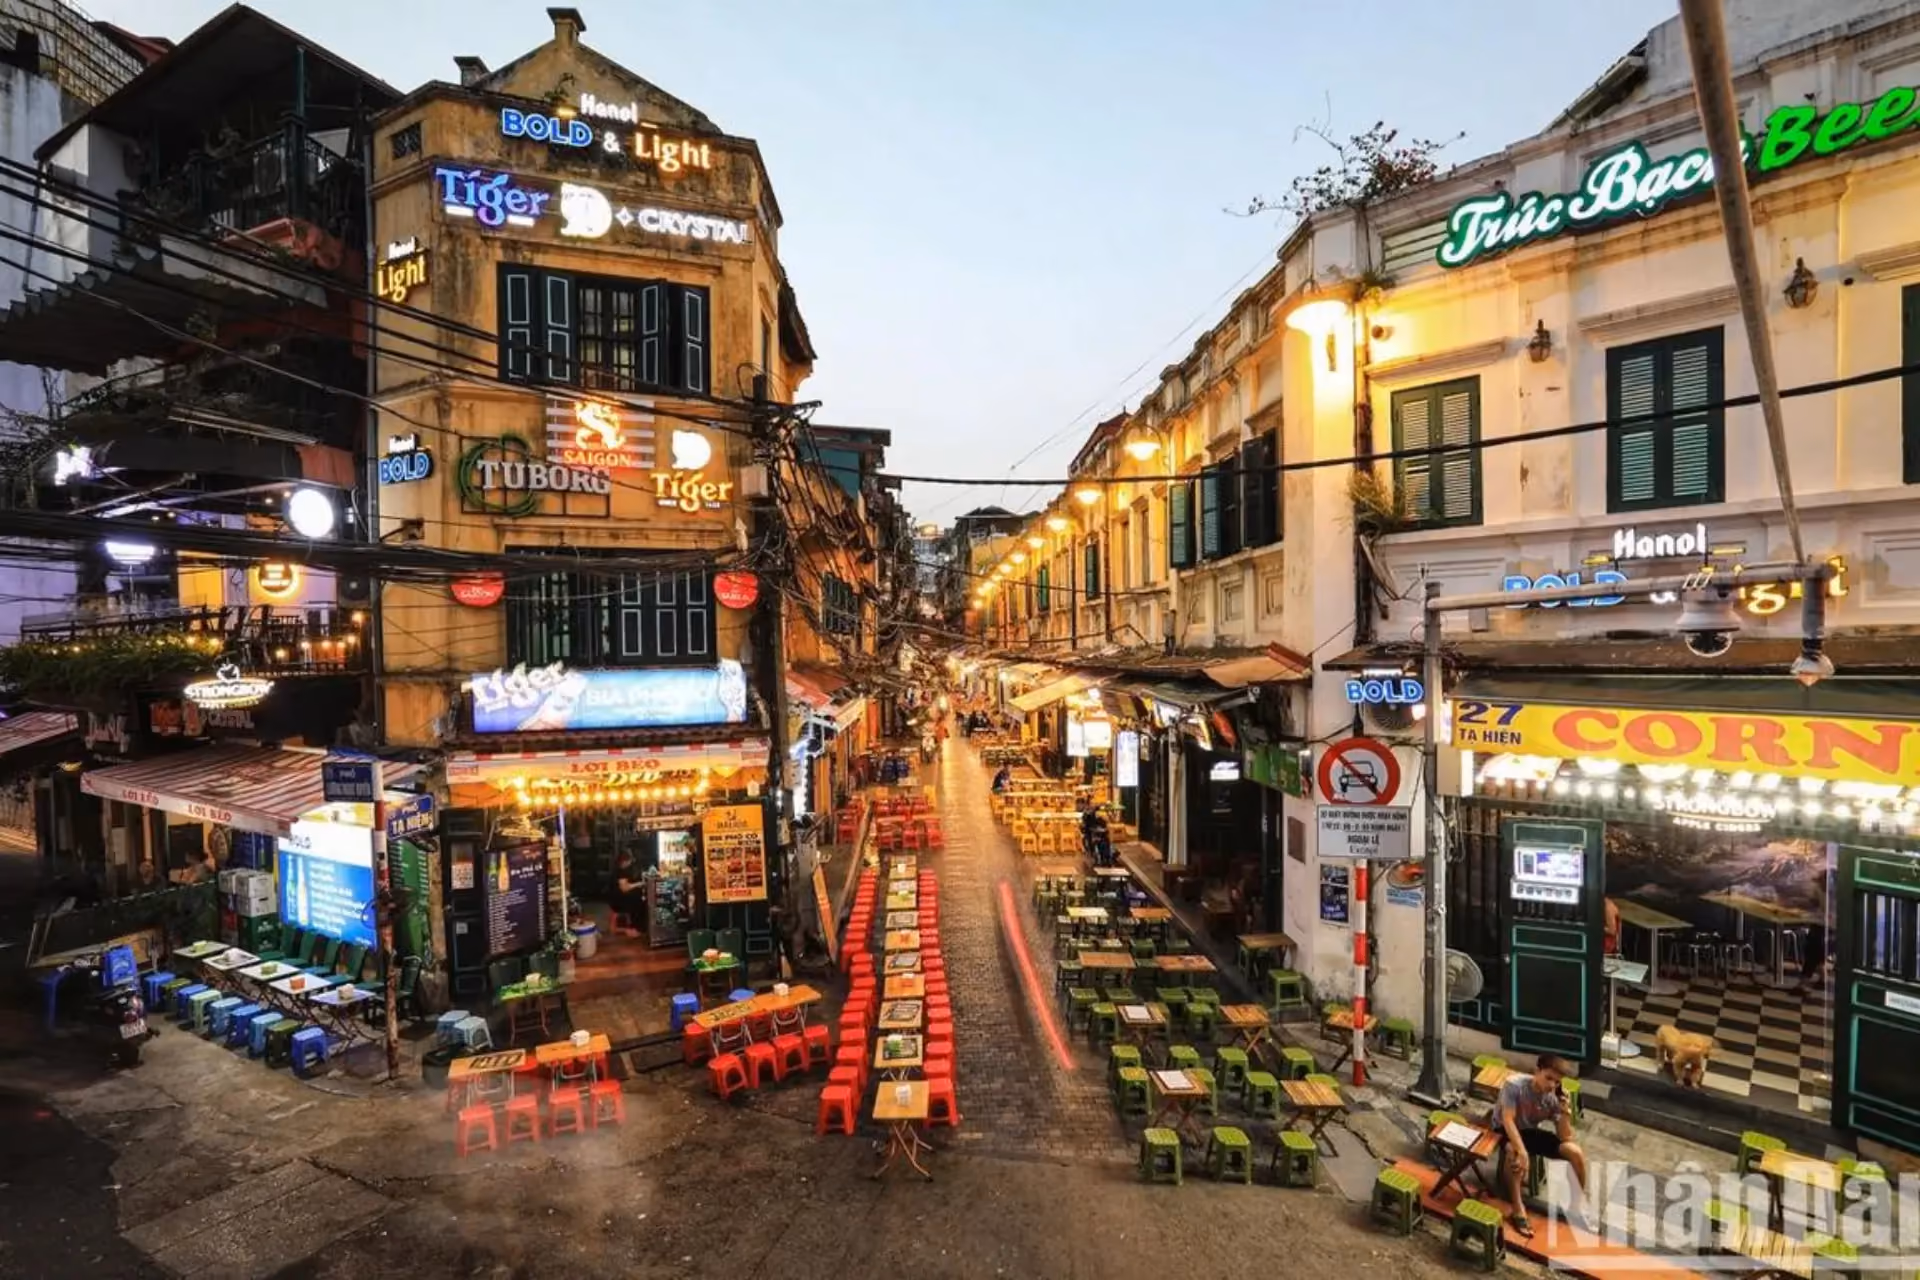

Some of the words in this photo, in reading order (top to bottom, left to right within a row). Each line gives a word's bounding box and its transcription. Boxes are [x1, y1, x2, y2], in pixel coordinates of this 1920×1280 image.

[502, 108, 593, 147] BOLD
[603, 131, 620, 153] &
[635, 131, 711, 173] Light
[1442, 196, 1562, 263] Trúc
[1758, 86, 1920, 172] Bee
[435, 167, 550, 227] Tiger
[377, 253, 426, 303] Light
[377, 452, 430, 484] BOLD
[477, 459, 611, 495] TUBORG
[562, 449, 632, 467] SAIGON
[651, 470, 734, 513] Tiger
[1503, 570, 1628, 609] BOLD
[1345, 679, 1424, 704] BOLD
[1458, 701, 1523, 726] 27
[1553, 707, 1920, 776] CORN
[1653, 794, 1777, 818] STRONGBOW
